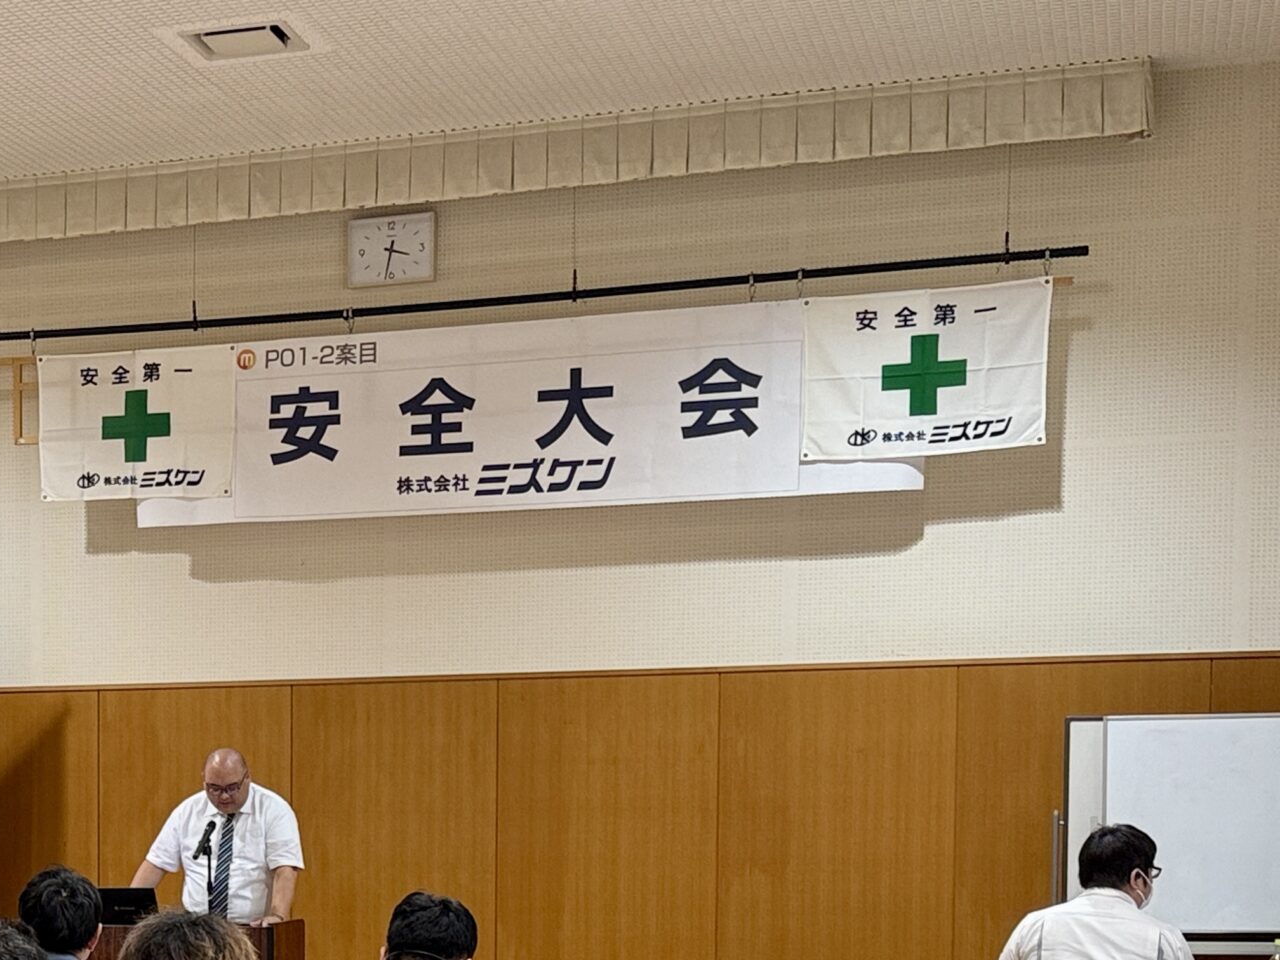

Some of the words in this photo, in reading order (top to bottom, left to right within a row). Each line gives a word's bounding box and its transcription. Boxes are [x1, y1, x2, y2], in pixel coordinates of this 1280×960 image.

[387, 220, 396, 231] 12
[358, 248, 366, 258] 9
[418, 242, 426, 253] 3
[388, 270, 396, 280] 6
[855, 303, 997, 332] 安全第一
[80, 362, 193, 387] 安全第一
[269, 357, 764, 466] 安全大会
